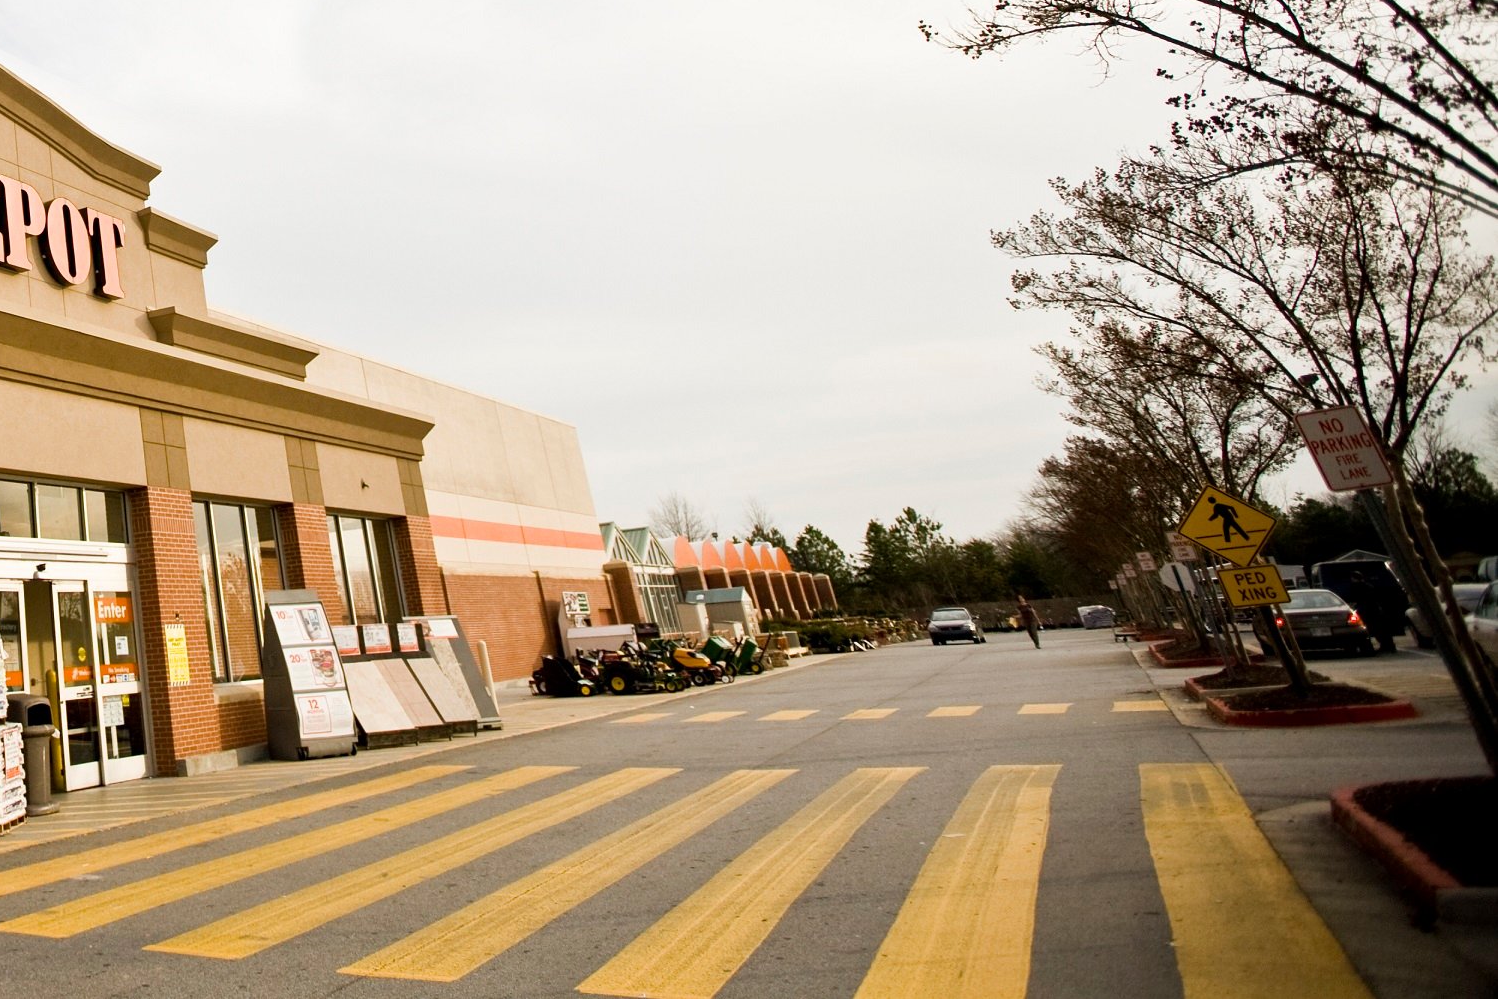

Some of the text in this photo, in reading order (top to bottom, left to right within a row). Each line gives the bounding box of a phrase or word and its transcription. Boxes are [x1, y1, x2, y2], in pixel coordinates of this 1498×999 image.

[1318, 418, 1344, 434] NO
[1311, 433, 1372, 455] PARKING
[1336, 453, 1362, 466] FIRE
[1340, 467, 1372, 481] LANE
[1234, 572, 1266, 586] PED
[1238, 587, 1277, 601] XING
[97, 600, 127, 619] Enter
[289, 654, 301, 663] 20
[308, 699, 319, 709] 12
